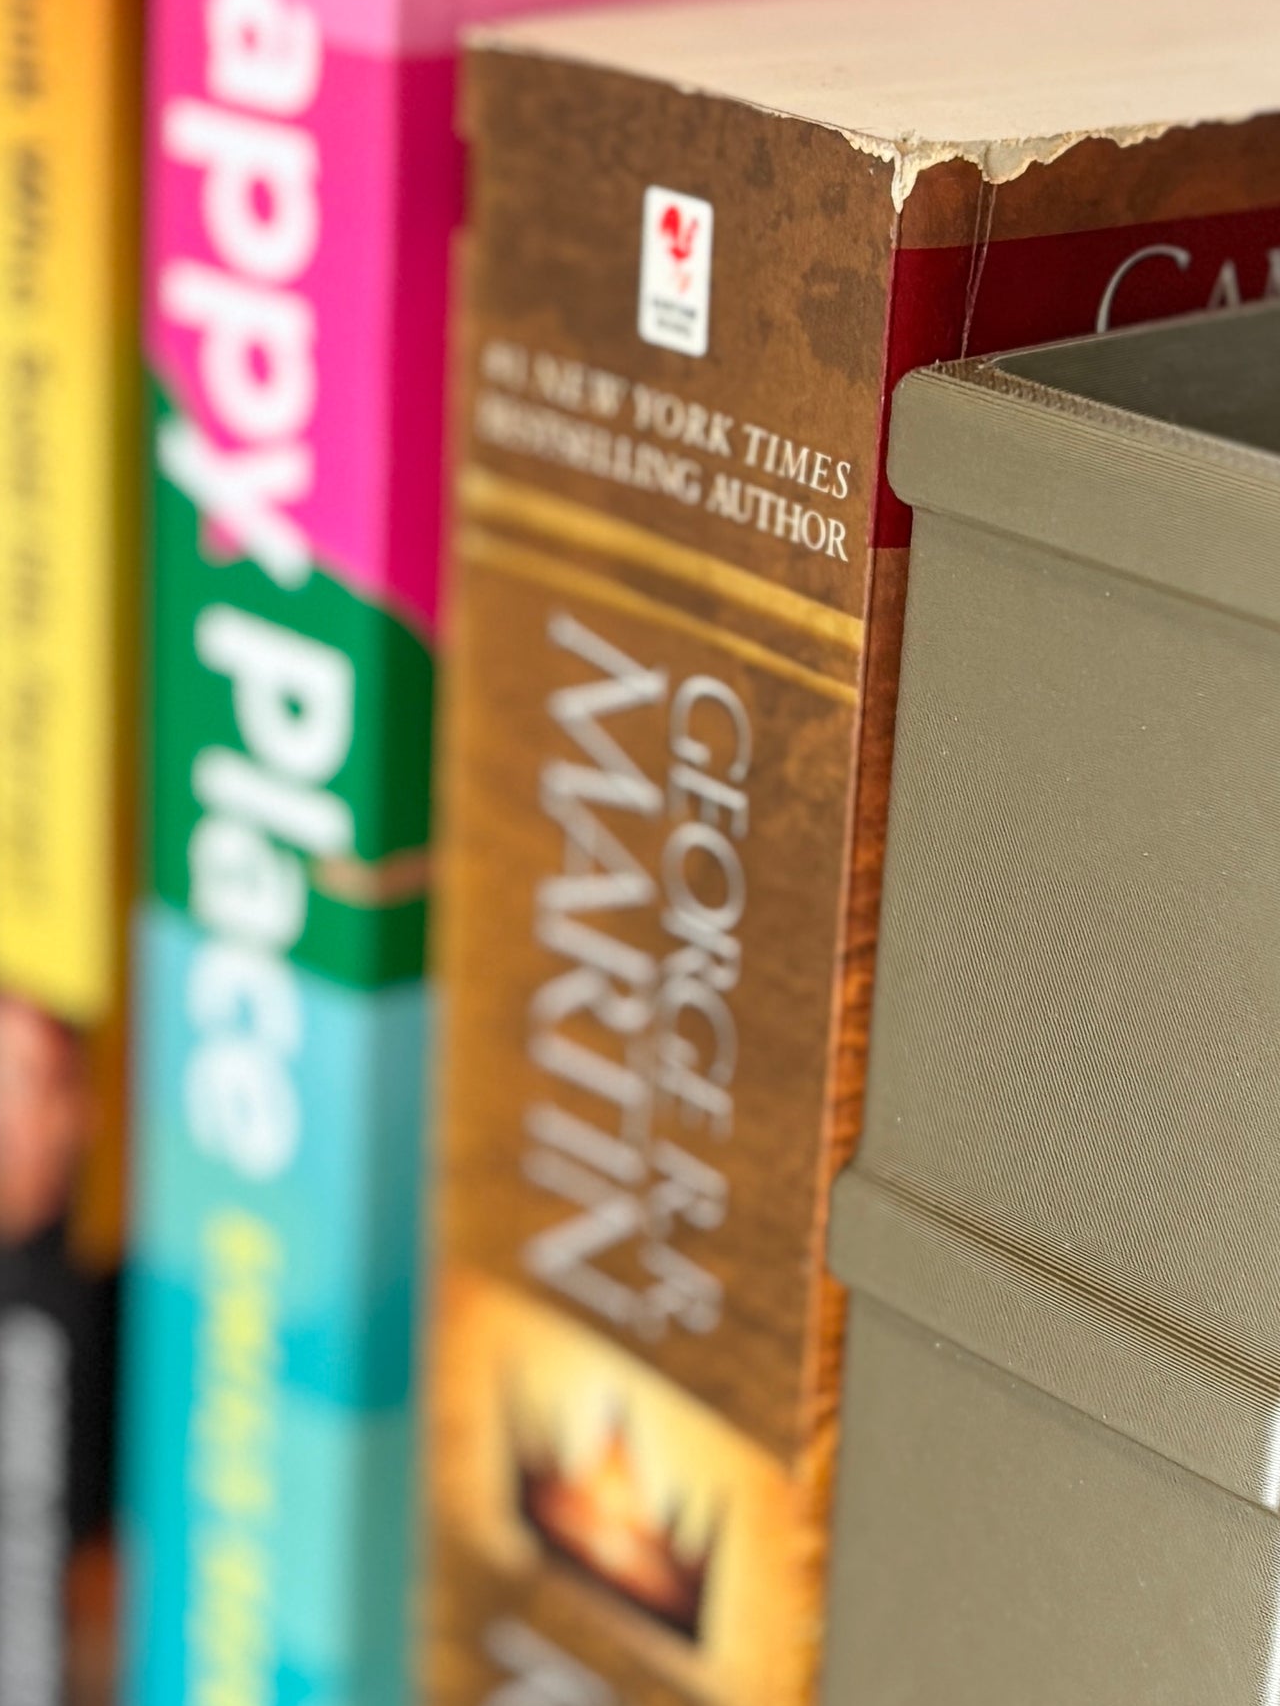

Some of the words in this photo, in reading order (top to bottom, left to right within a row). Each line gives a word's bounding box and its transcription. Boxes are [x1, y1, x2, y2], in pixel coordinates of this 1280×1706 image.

[533, 351, 631, 420] NEW
[632, 381, 734, 460] YORK
[742, 423, 852, 501] TIMES
[705, 470, 850, 563] AUTHOR
[184, 602, 356, 1181] Place
[520, 611, 668, 1328] MARTIN
[656, 673, 753, 1142] GEORGE
